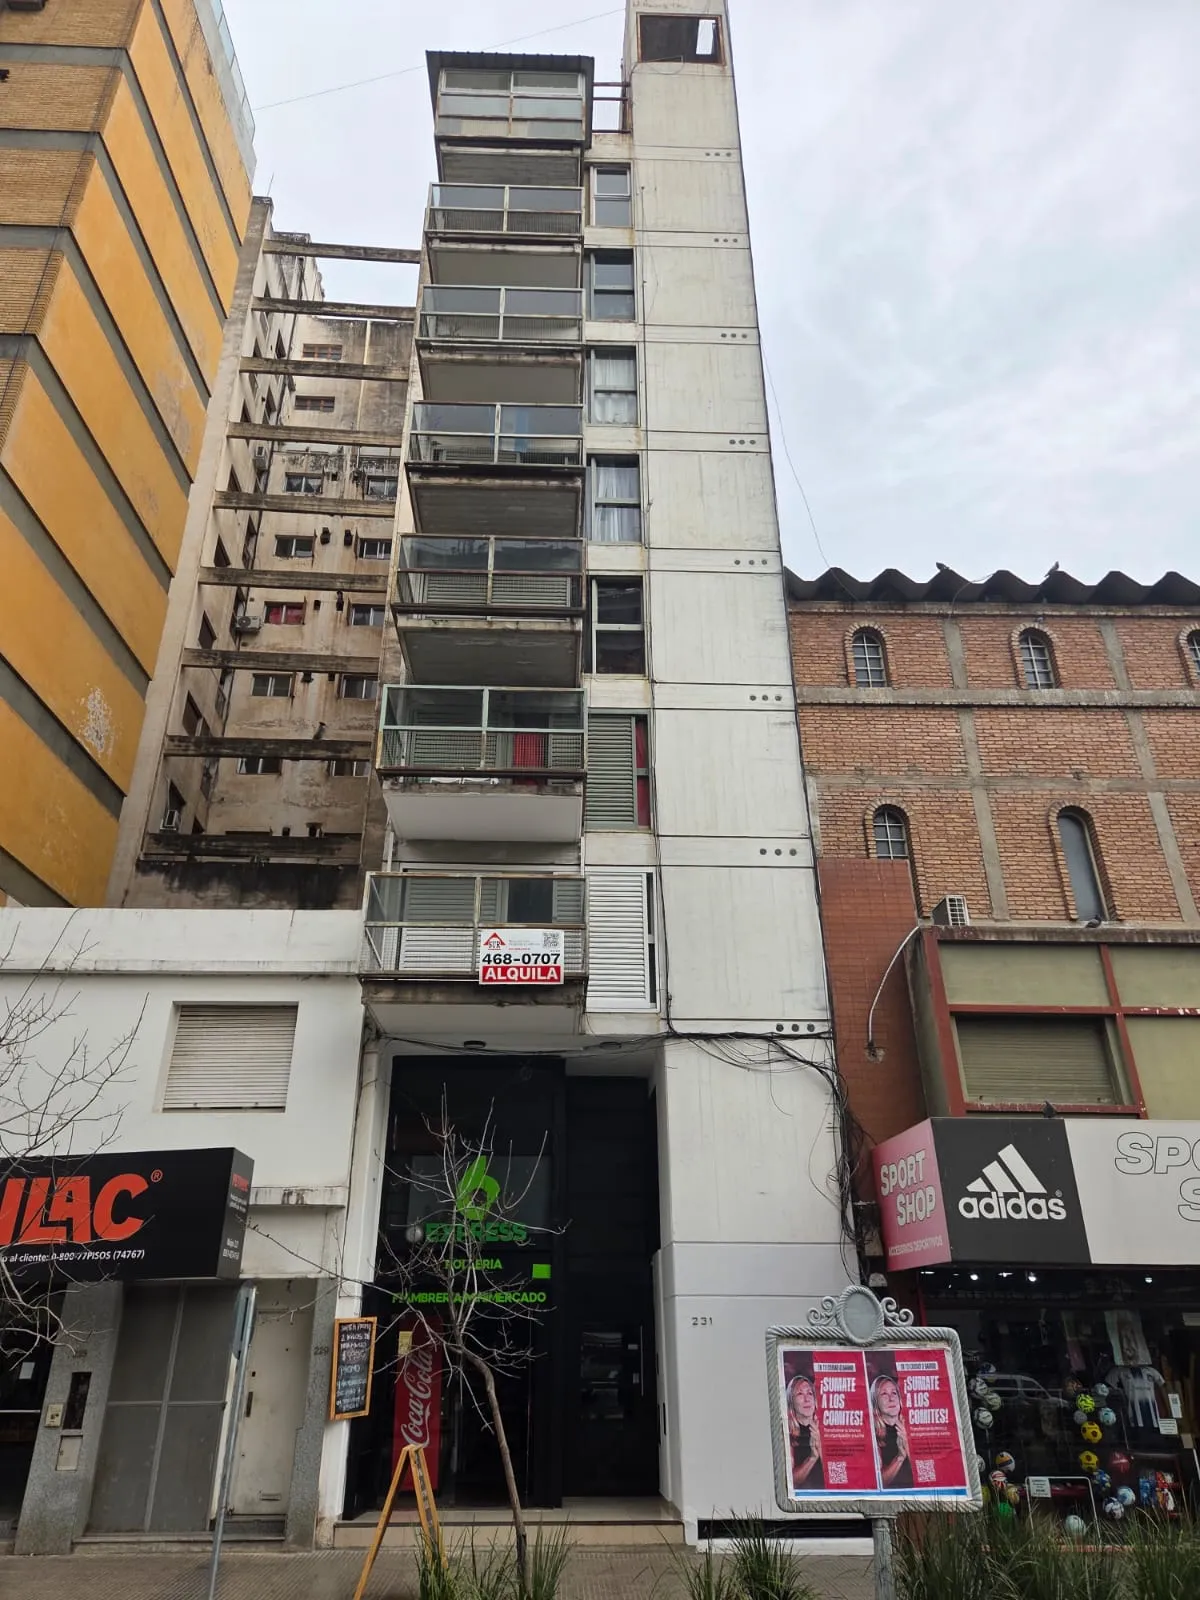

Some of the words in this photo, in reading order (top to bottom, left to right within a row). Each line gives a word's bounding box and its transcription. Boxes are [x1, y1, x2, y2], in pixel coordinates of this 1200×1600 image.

[482, 953, 560, 965] 468-0707
[484, 967, 558, 981] ALQUILA
[1114, 1131, 1200, 1175] SP
[881, 1149, 926, 1196] SPORT
[896, 1185, 936, 1227] SHOP
[958, 1191, 1067, 1220] adidas
[10, 1253, 19, 1262] al
[19, 1253, 49, 1262] cliente:
[113, 1249, 145, 1261] (74767)
[691, 1316, 713, 1326] 231
[821, 1393, 828, 1409] A
[829, 1393, 846, 1409] LOS
[906, 1392, 913, 1408] A
[914, 1391, 930, 1408] LOS
